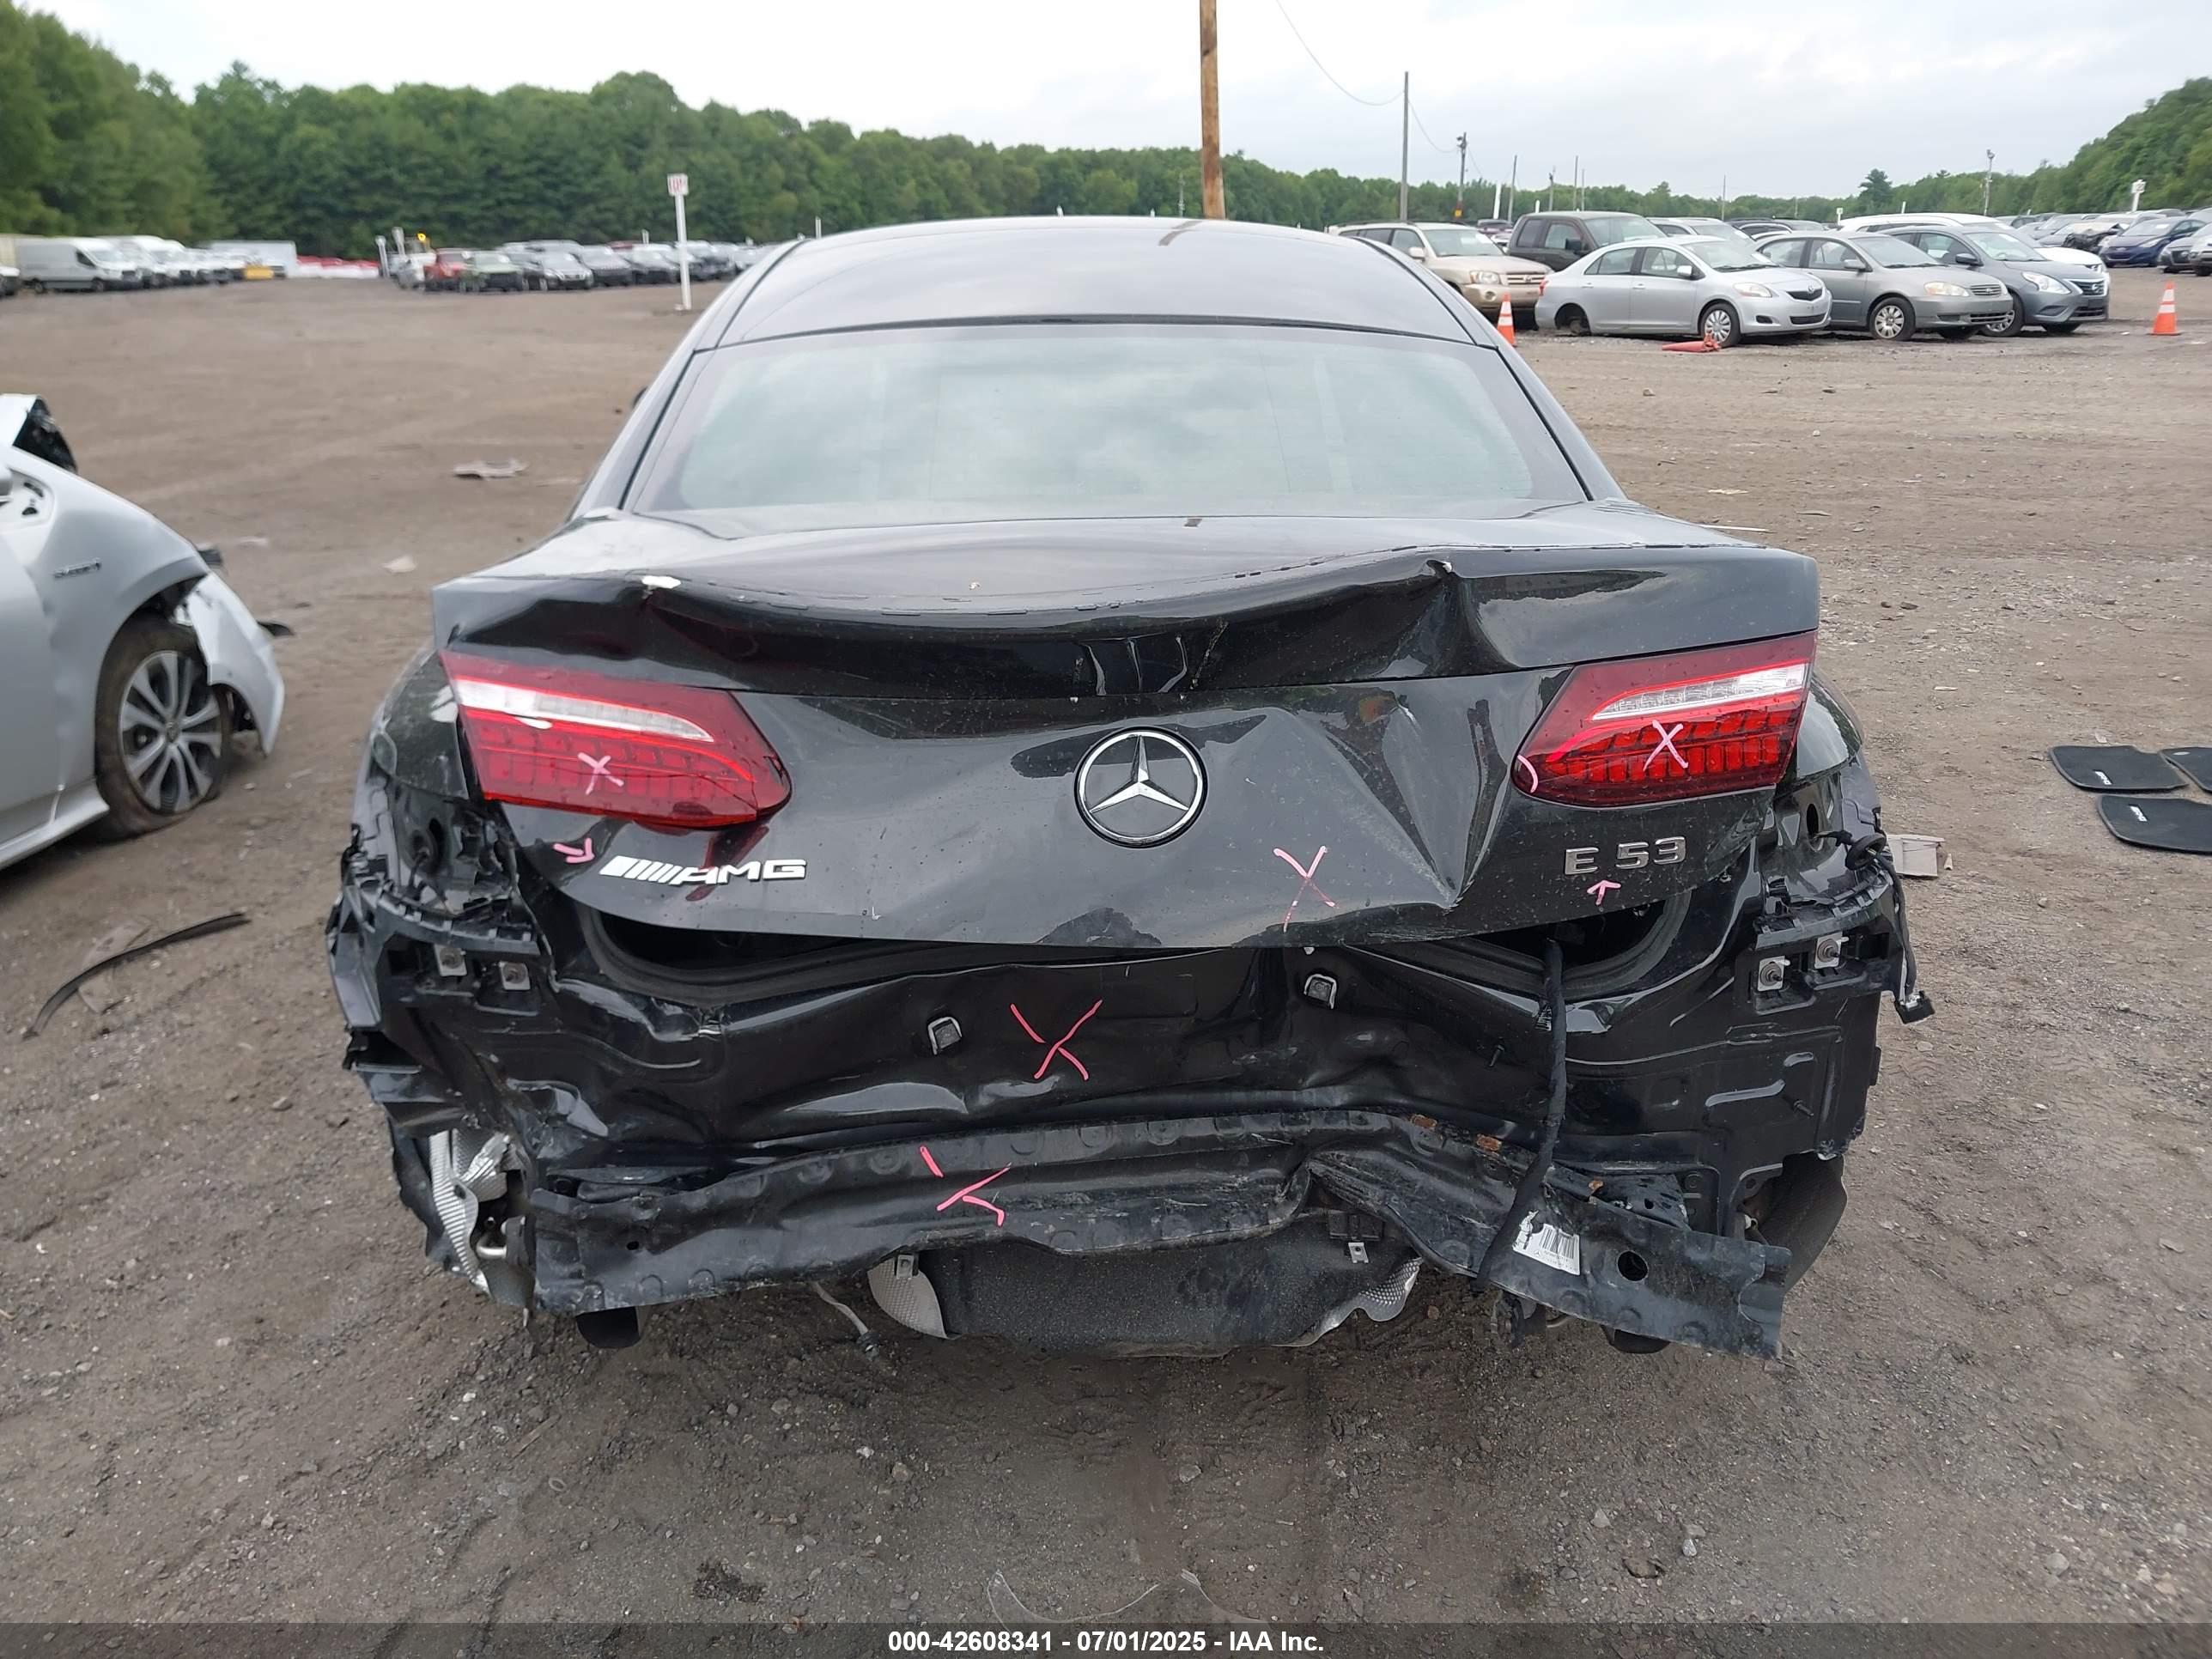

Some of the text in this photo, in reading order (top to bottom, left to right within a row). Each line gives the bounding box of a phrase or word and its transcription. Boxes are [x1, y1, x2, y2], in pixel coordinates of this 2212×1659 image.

[1564, 836, 1686, 875] E 53
[668, 859, 806, 885] AMG
